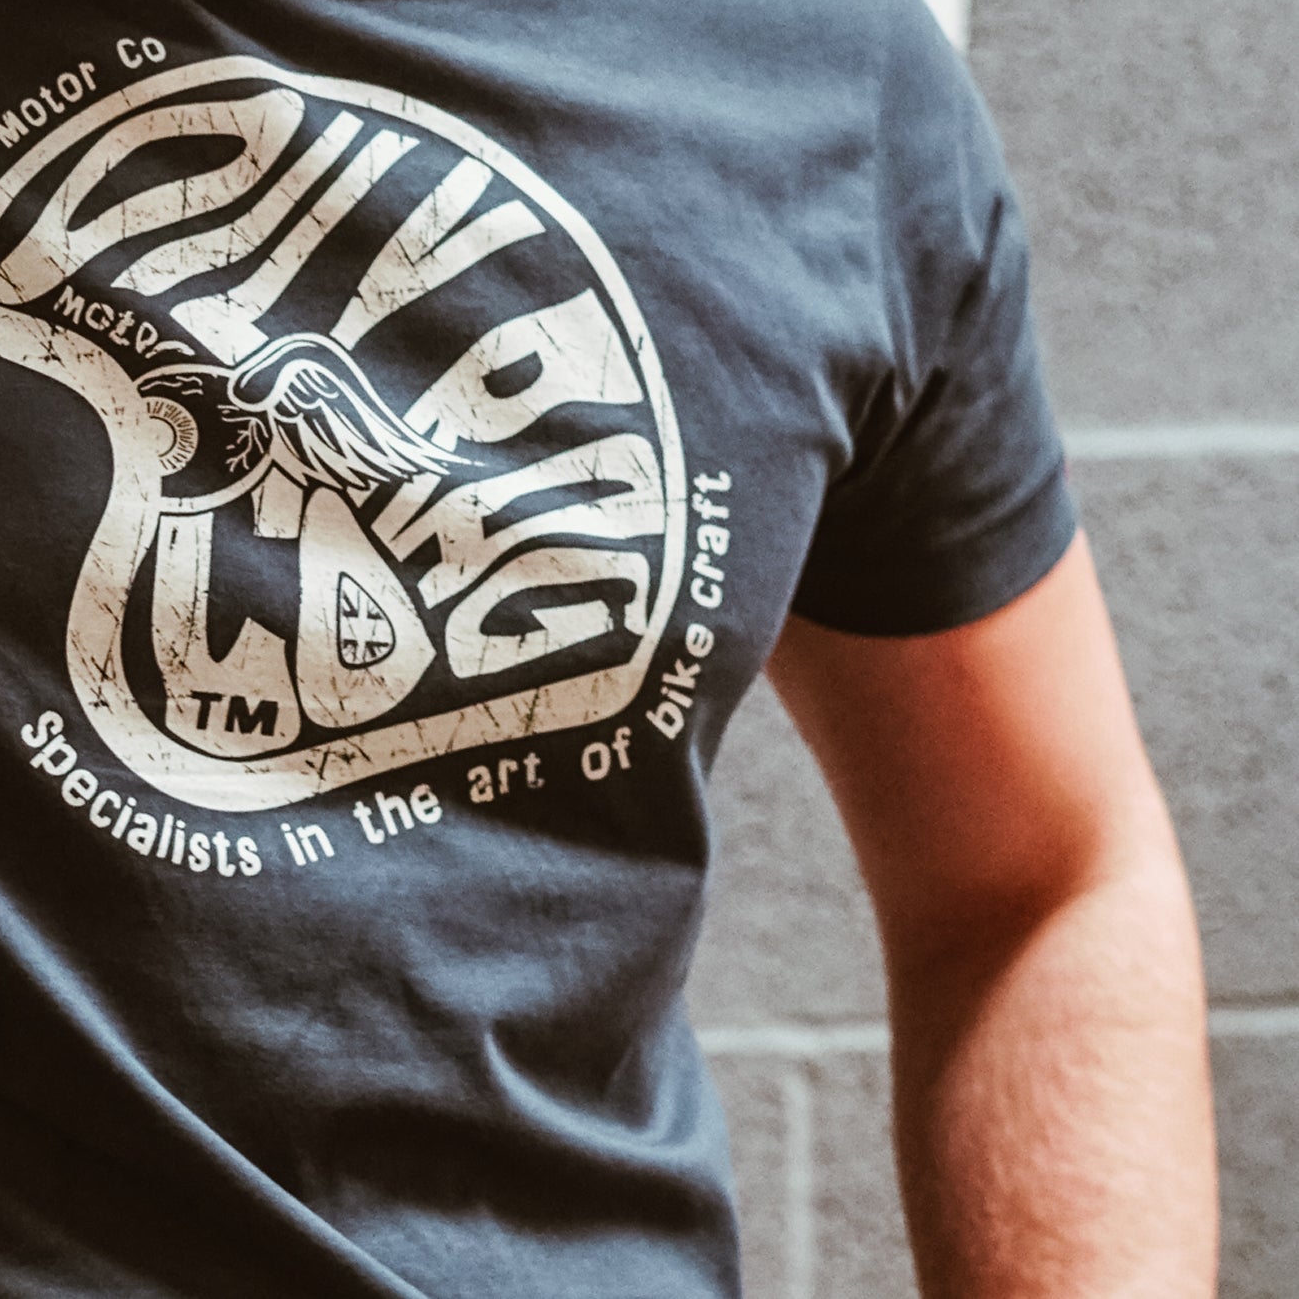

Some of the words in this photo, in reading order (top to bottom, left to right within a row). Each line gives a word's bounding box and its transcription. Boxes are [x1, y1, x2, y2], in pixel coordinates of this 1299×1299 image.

[116, 36, 167, 69] Co
[20, 709, 263, 878] Specialists
[279, 821, 335, 866] in
[353, 783, 443, 844] the
[467, 751, 545, 804] art
[580, 726, 633, 781] of
[645, 622, 716, 741] bike
[690, 470, 733, 609] craft
[190, 690, 279, 737] TM
